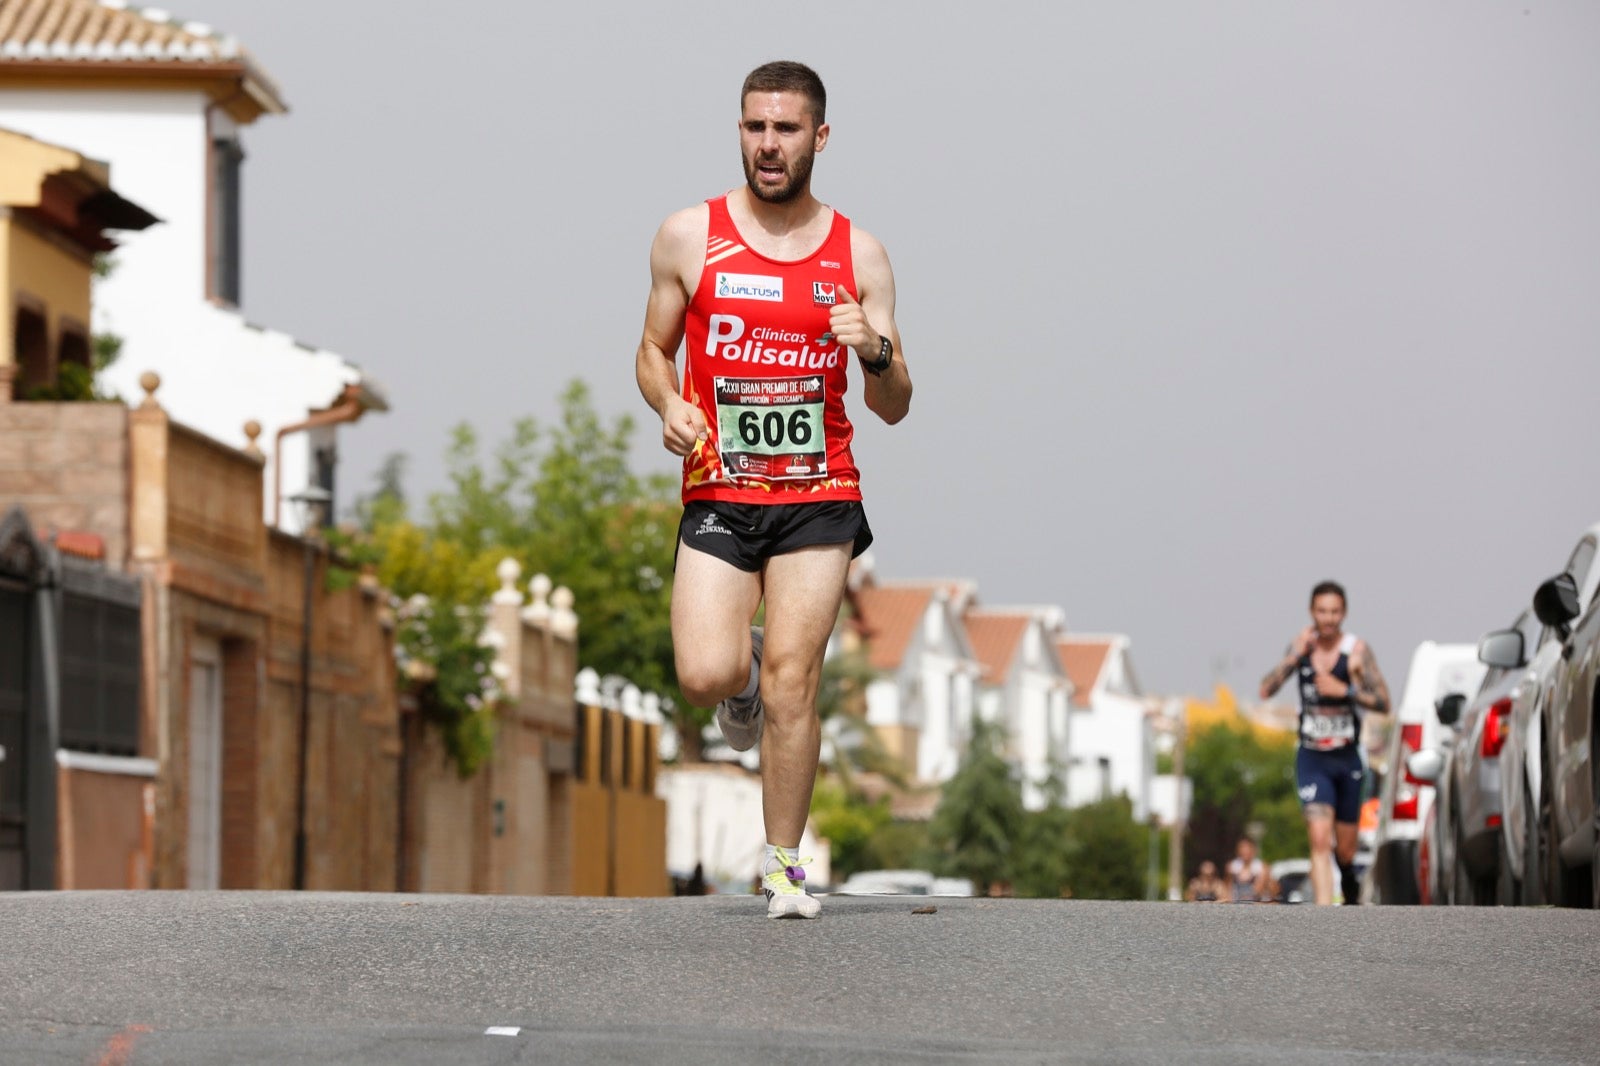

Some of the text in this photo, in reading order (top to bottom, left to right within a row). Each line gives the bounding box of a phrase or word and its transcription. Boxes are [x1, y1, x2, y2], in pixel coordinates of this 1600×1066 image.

[815, 283, 819, 294] I
[814, 295, 835, 303] MOVE
[705, 314, 841, 369] Polisalud
[752, 327, 807, 343] Clínicas
[741, 382, 760, 394] GRAN
[761, 381, 788, 394] PREMIO
[790, 381, 799, 393] DE
[738, 409, 812, 447] 606
